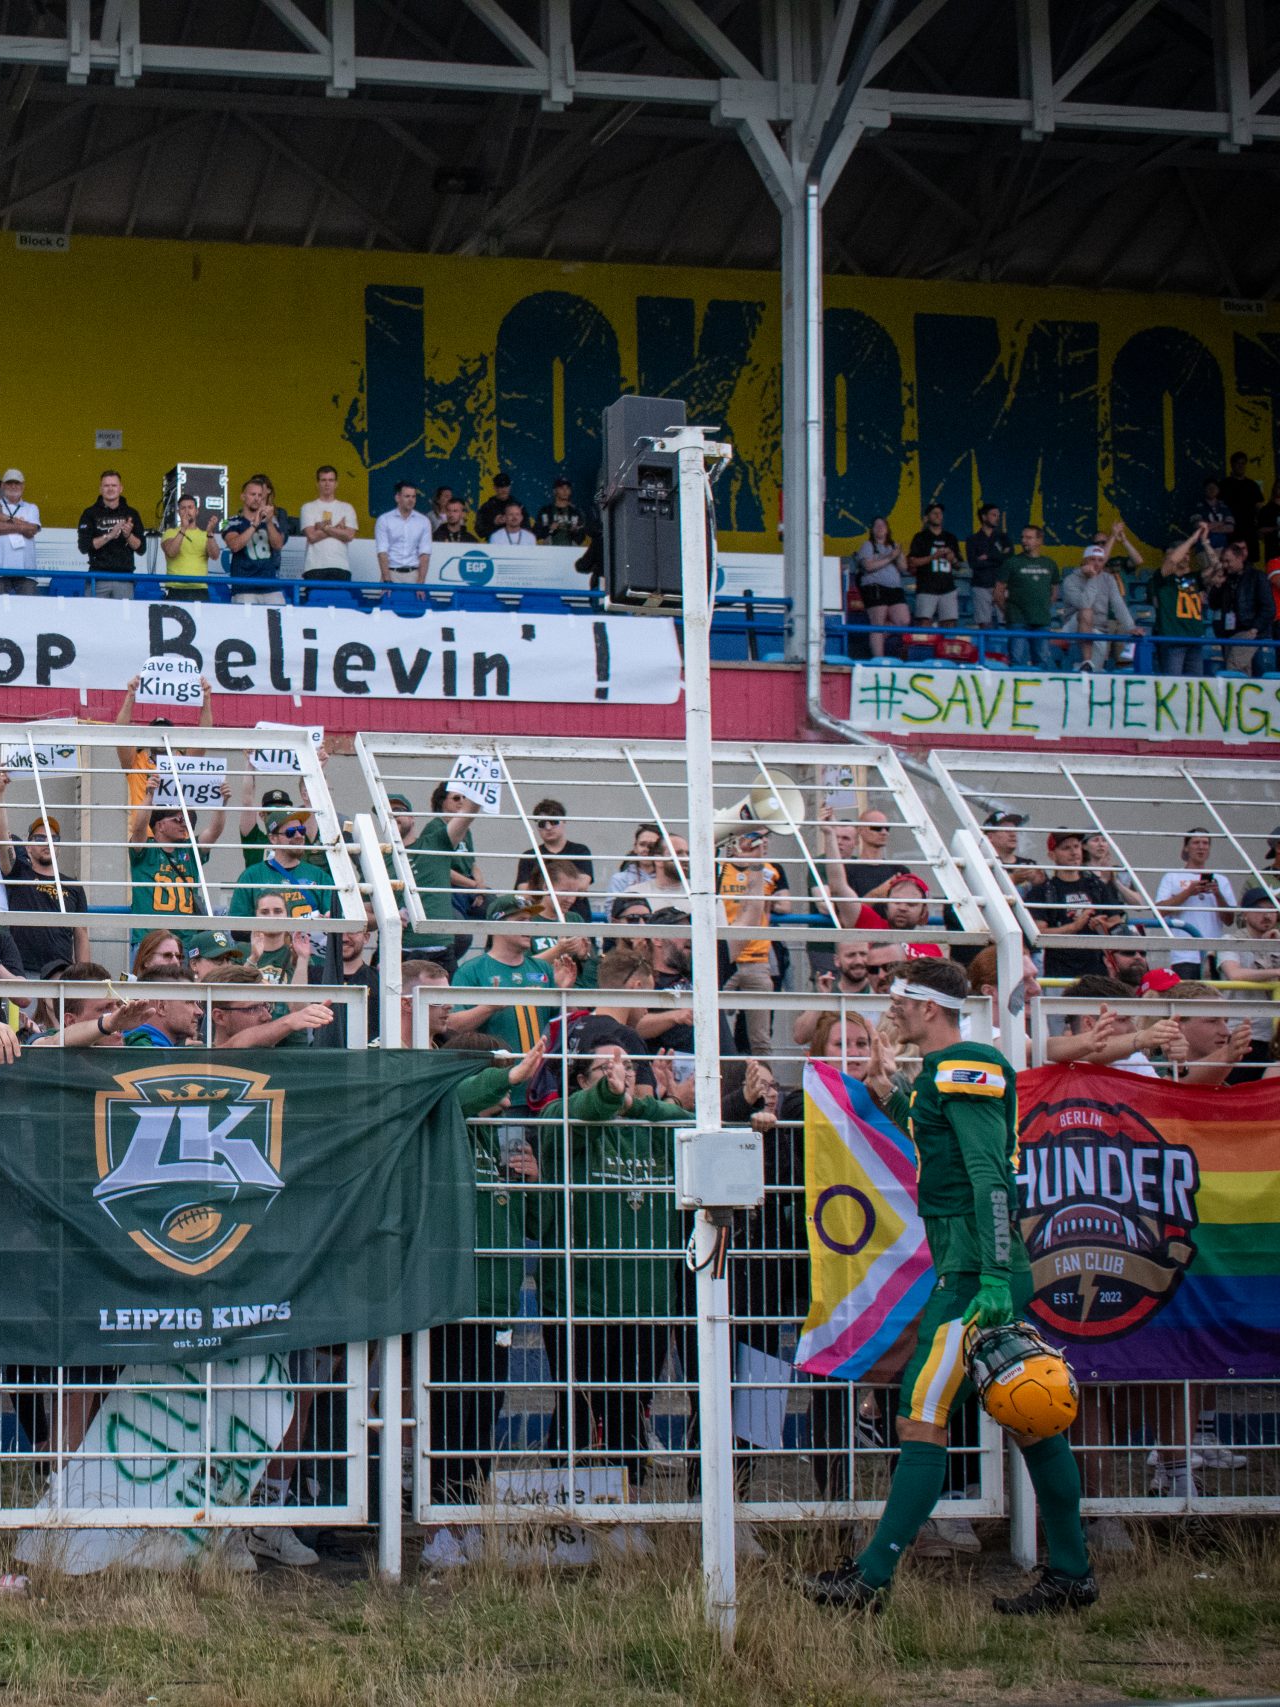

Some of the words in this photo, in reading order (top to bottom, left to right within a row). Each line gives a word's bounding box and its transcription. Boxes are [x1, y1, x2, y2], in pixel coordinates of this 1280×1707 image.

[465, 561, 488, 574] EGP
[148, 603, 536, 697] Believin'
[139, 677, 201, 702] Kings
[1059, 1110, 1104, 1128] BERLIN
[93, 1106, 286, 1197] LK
[1014, 1147, 1194, 1222] HUNDER
[990, 1190, 1011, 1263] KINGS
[1055, 1254, 1082, 1276] FAN
[1085, 1252, 1125, 1275] CLUB
[1053, 1293, 1078, 1305] EST.
[1099, 1291, 1123, 1303] 2022
[99, 1308, 203, 1332] LEIPZIG
[212, 1300, 292, 1330] KINGS
[172, 1338, 195, 1349] est.
[197, 1336, 222, 1348] 2021
